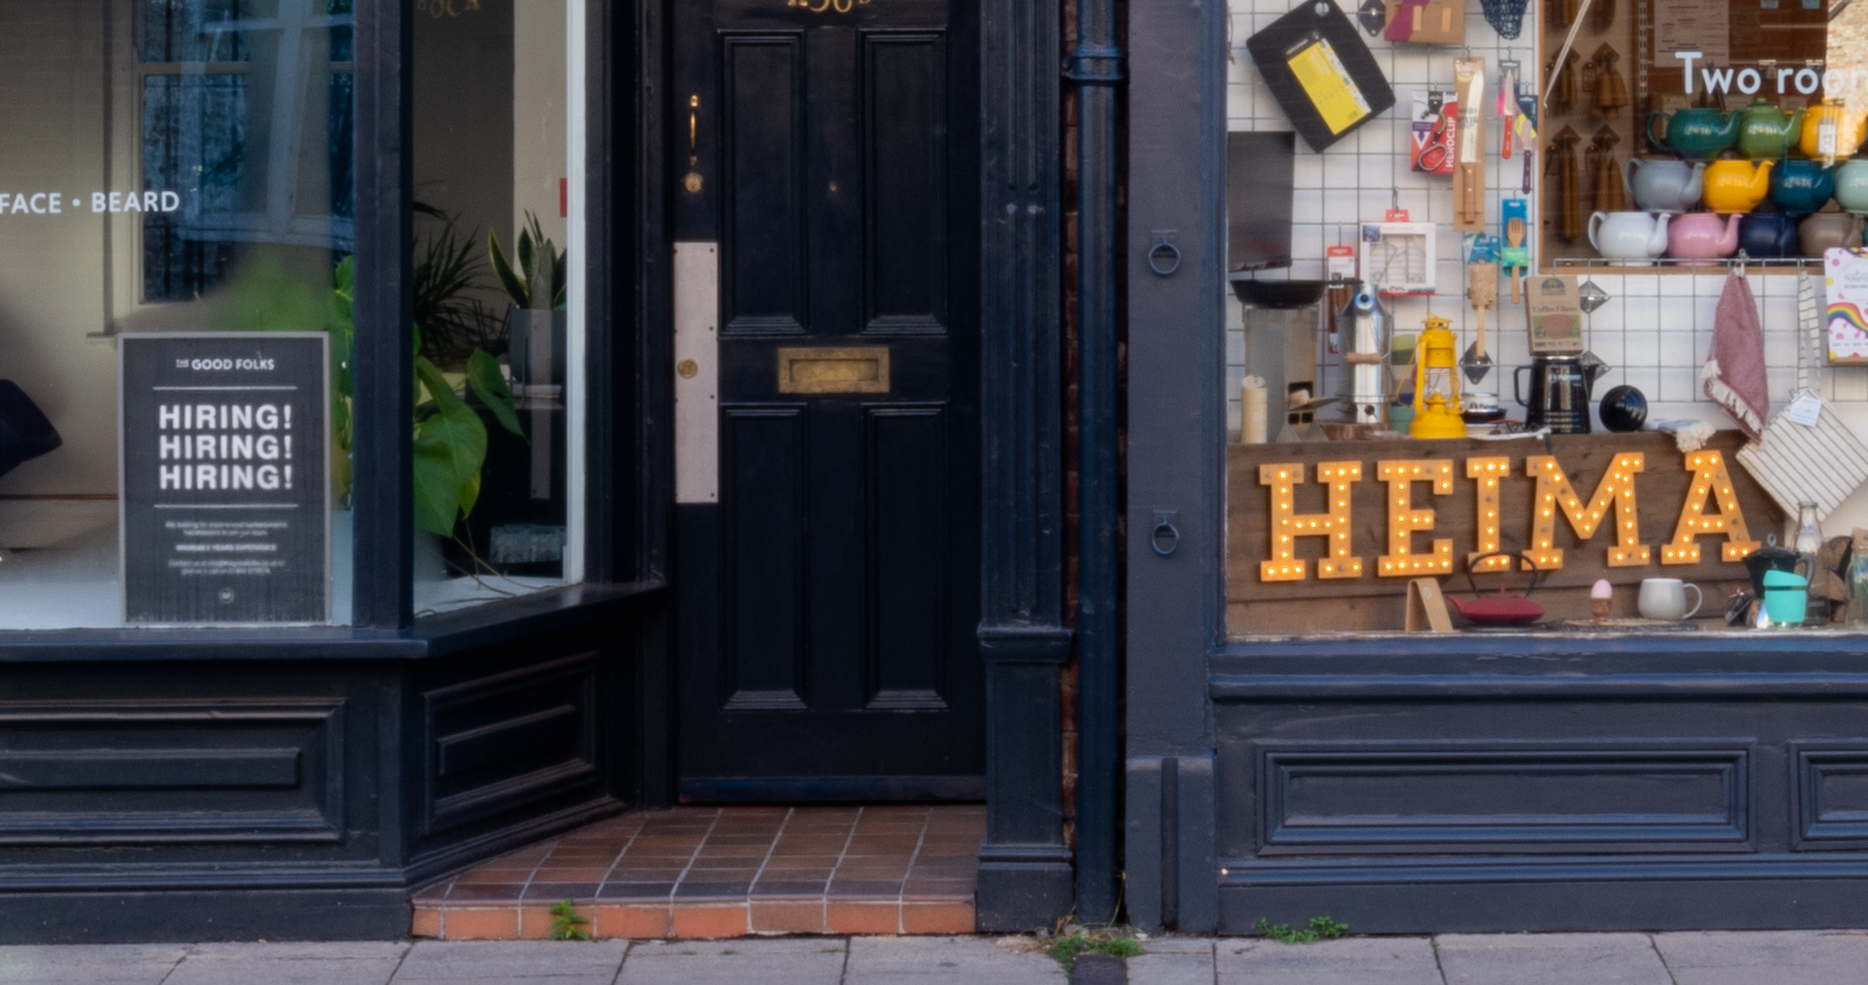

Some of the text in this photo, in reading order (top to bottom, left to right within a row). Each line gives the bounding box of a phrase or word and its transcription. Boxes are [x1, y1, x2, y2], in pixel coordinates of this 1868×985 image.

[1675, 51, 1761, 96] Two
[91, 190, 180, 214] BEARD
[191, 358, 233, 371] GOOD
[235, 358, 275, 370] FOLKS
[159, 405, 292, 429] HIRING!
[159, 435, 292, 459] HIRING!
[160, 465, 293, 490] HIRING!
[1259, 450, 1761, 582] HEIMA
